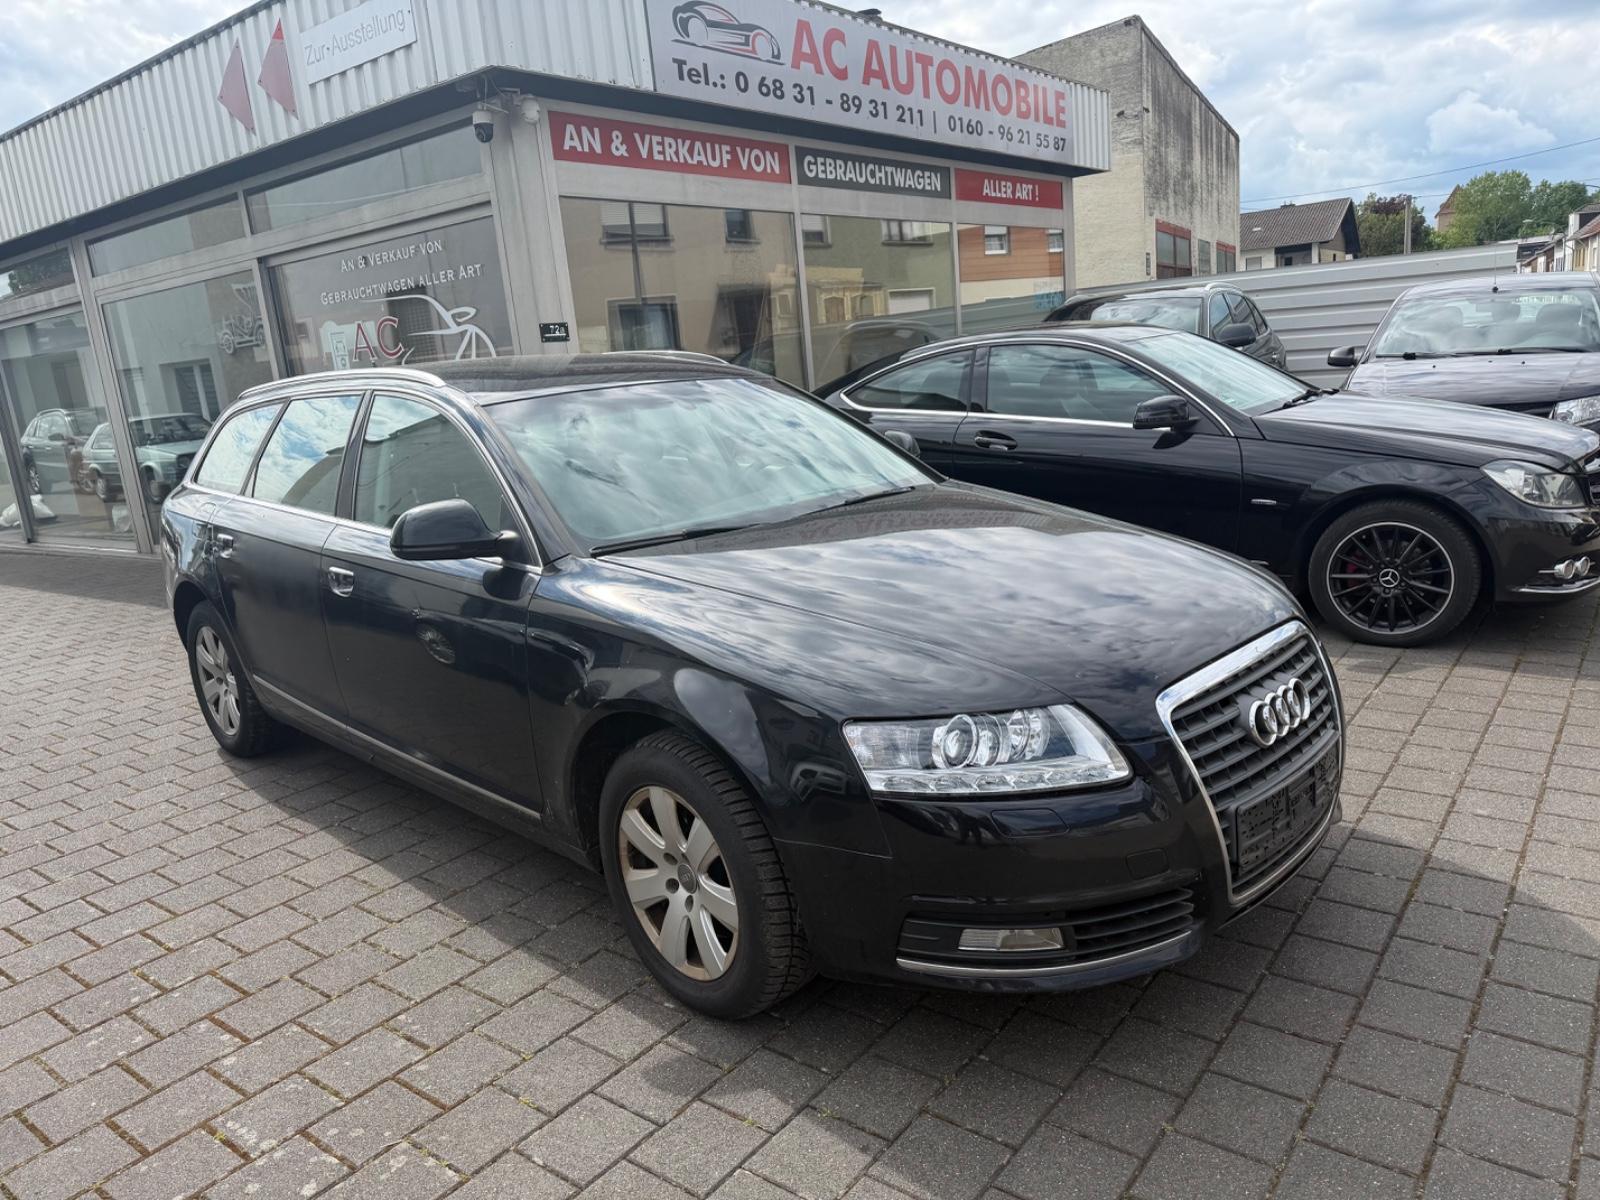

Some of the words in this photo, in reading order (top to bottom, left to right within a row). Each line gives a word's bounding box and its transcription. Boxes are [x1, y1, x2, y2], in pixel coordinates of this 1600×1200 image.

[304, 44, 326, 66] Zur
[332, 9, 406, 56] Ausstellung
[790, 18, 848, 81] AC
[861, 38, 1066, 128] AUTOMOBILE
[671, 57, 726, 89] Tel.:
[734, 71, 749, 93] 0
[758, 75, 785, 100] 68
[792, 82, 815, 106] 31
[839, 92, 862, 114] 89
[868, 98, 888, 120] 31
[896, 104, 924, 127] 211
[947, 115, 983, 136] 0160
[998, 124, 1013, 142] 96
[1016, 128, 1031, 145] 21
[1035, 134, 1050, 149] 55
[1053, 136, 1066, 151] 87
[563, 123, 602, 154] AN
[610, 130, 629, 158] &
[633, 132, 732, 169] VERKAUF
[736, 146, 780, 174] VON
[803, 154, 941, 191] GEBRAUCHTWAGEN
[982, 178, 1013, 199] ALLER
[1015, 182, 1033, 201] ART
[358, 255, 366, 269] &
[368, 245, 415, 267] VERKAUF
[419, 239, 442, 255] VON
[320, 276, 415, 305] GEBRAUCHTWAGEN
[419, 268, 454, 287] ALLER
[458, 263, 482, 280] ART
[352, 316, 405, 362] AC
